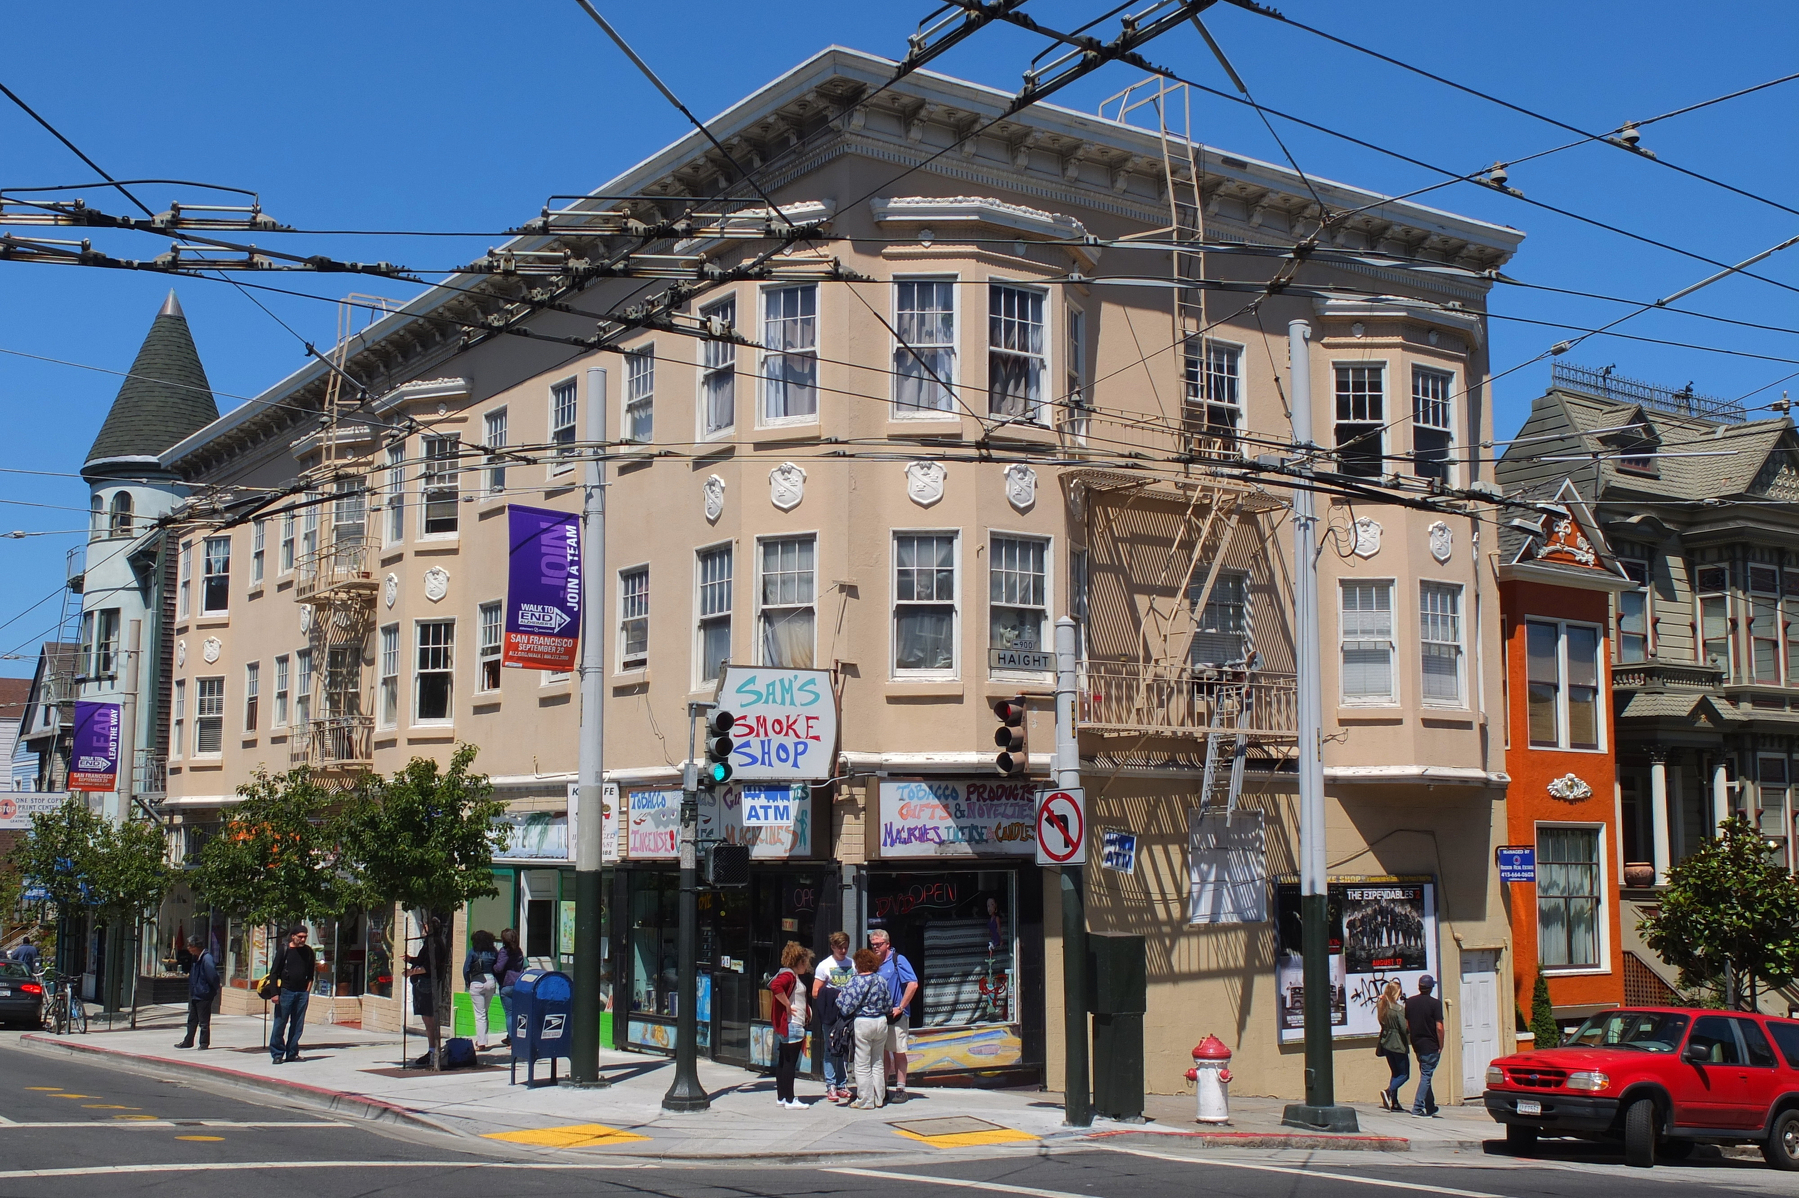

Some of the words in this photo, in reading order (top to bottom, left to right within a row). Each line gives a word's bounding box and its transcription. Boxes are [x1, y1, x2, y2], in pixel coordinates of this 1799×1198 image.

[566, 525, 578, 561] TEAM
[568, 566, 579, 575] A
[567, 578, 579, 611] JOIN
[521, 603, 542, 612] WALK
[521, 612, 552, 622] END
[510, 634, 528, 643] SAN
[530, 636, 573, 647] FRANCISCO
[518, 644, 555, 653] SEPTEMBER
[998, 654, 1048, 667] HAIGHT
[736, 674, 820, 708] SAM'S
[92, 709, 111, 757] LEAD
[110, 727, 118, 740] THE
[733, 714, 821, 742] SMOKE
[733, 738, 808, 769] SHOP
[744, 785, 766, 794] CITY
[896, 783, 959, 801] TOBACCO
[965, 784, 1038, 802] PRODUCTS
[630, 790, 666, 810] TOBACCO
[747, 805, 789, 821] ATM
[898, 801, 952, 820] GIFTS
[725, 824, 799, 853] MAGAZINES
[1105, 850, 1132, 869] ATM
[909, 883, 956, 903] OPEN
[1347, 891, 1362, 900] THE
[1364, 890, 1413, 900] EXPENDABLES
[1416, 891, 1420, 899] 2
[875, 893, 915, 917] DVD
